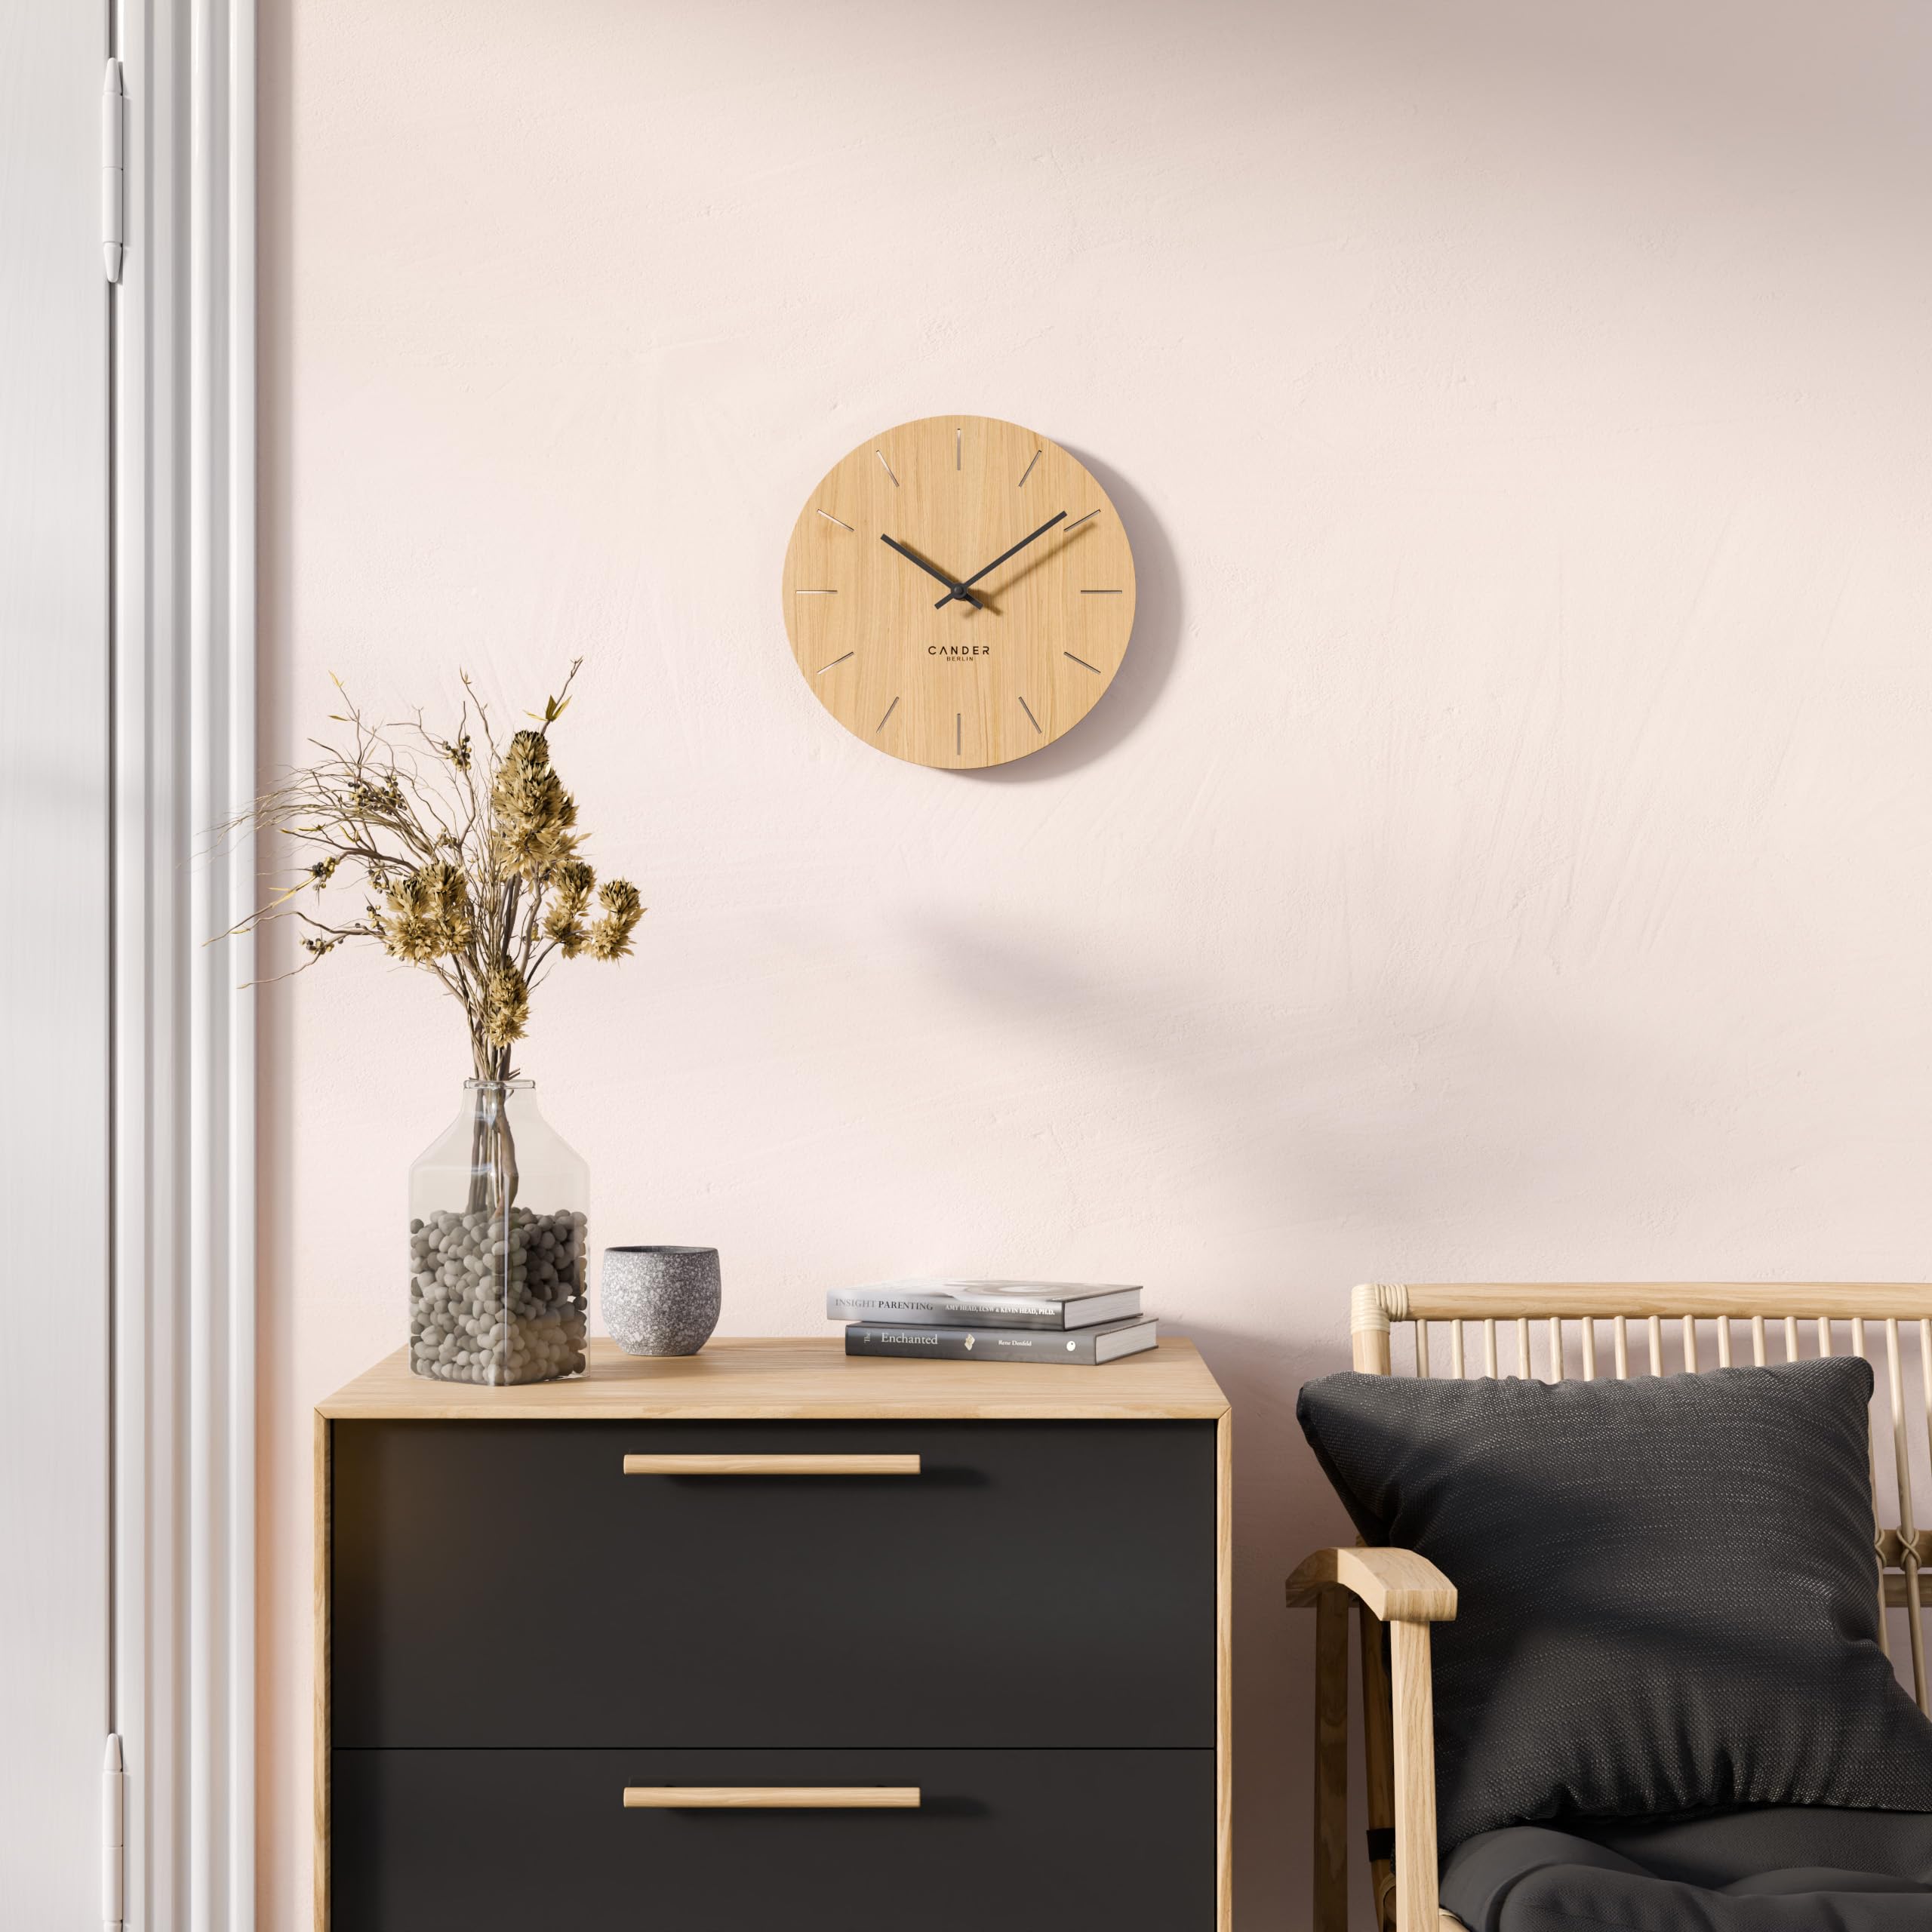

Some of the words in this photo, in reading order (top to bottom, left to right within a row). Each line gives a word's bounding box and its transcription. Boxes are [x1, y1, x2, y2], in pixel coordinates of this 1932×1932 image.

[928, 646, 989, 655] CANDER
[835, 1298, 875, 1309] INSIGHT
[878, 1300, 934, 1311] PARENTING
[1019, 1307, 1038, 1315] HEAD,
[881, 1331, 938, 1345] Enchanted
